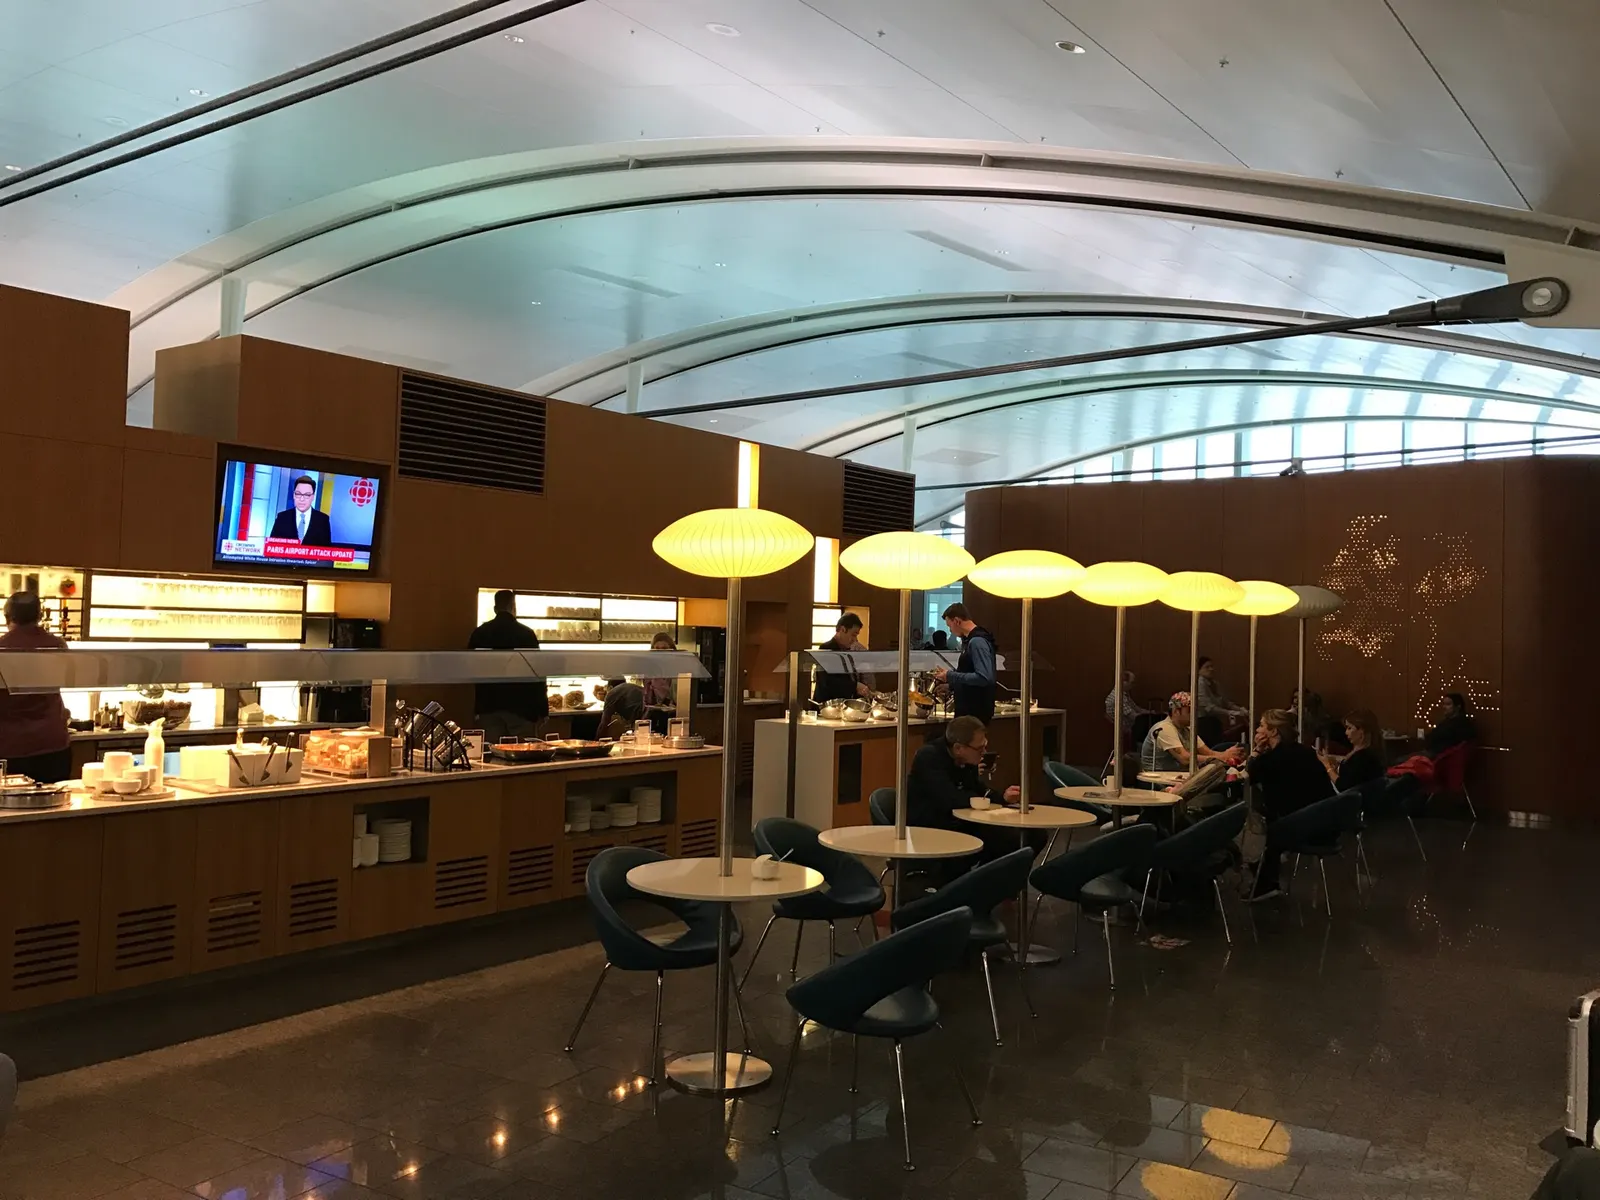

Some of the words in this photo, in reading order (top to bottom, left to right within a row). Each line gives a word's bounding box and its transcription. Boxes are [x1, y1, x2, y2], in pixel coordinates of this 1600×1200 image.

[285, 547, 309, 555] AIRPORT
[309, 549, 331, 557] ATTACK
[331, 550, 353, 558] UPDATE
